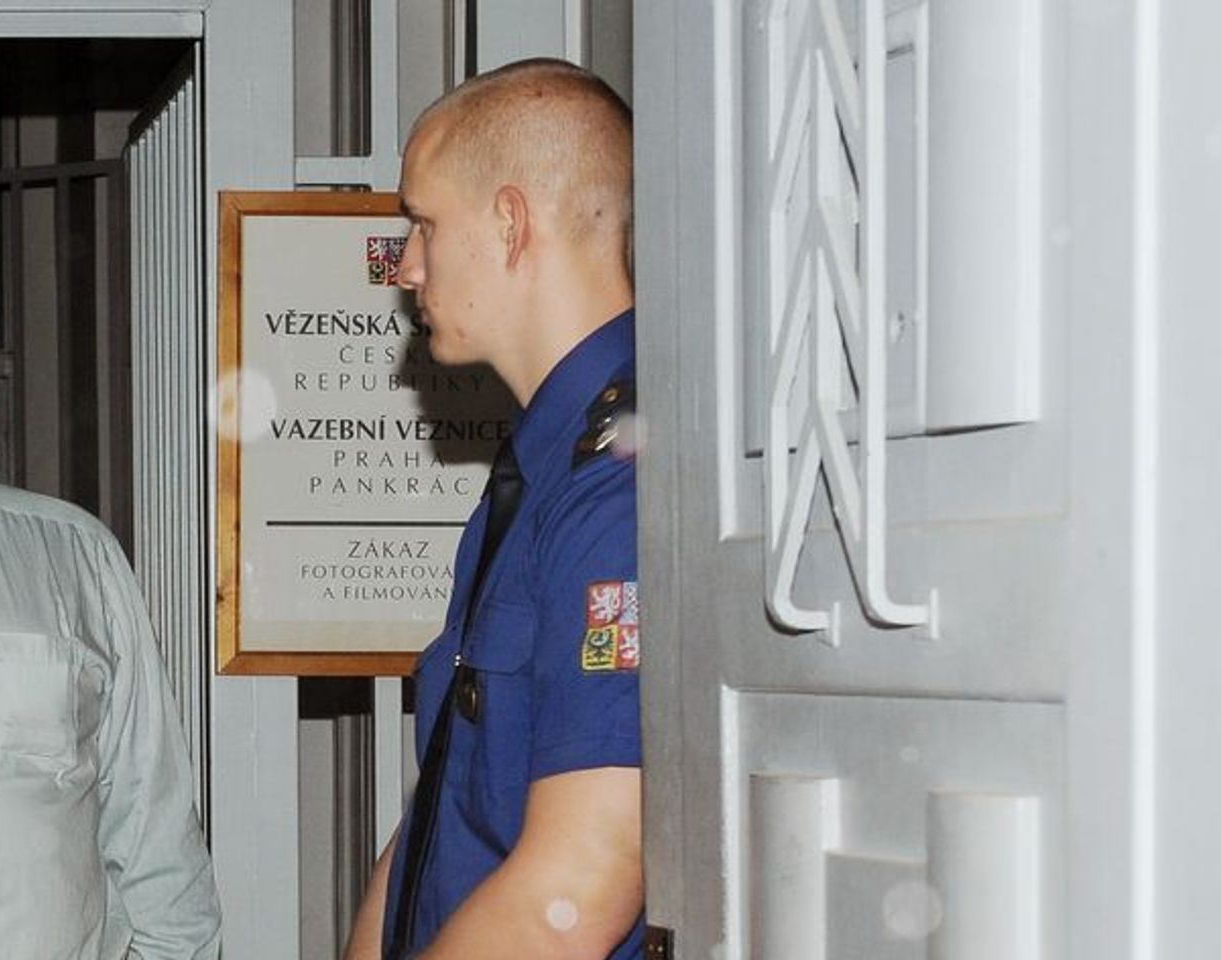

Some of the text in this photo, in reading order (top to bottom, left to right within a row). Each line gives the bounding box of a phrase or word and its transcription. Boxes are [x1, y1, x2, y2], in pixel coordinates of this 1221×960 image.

[265, 310, 401, 336] VĚZEŇSKÁ
[271, 415, 386, 440] VAZEBNÍ
[334, 450, 446, 468] PRAHA
[347, 540, 431, 559] ZÁKAZ
[323, 586, 335, 600] A
